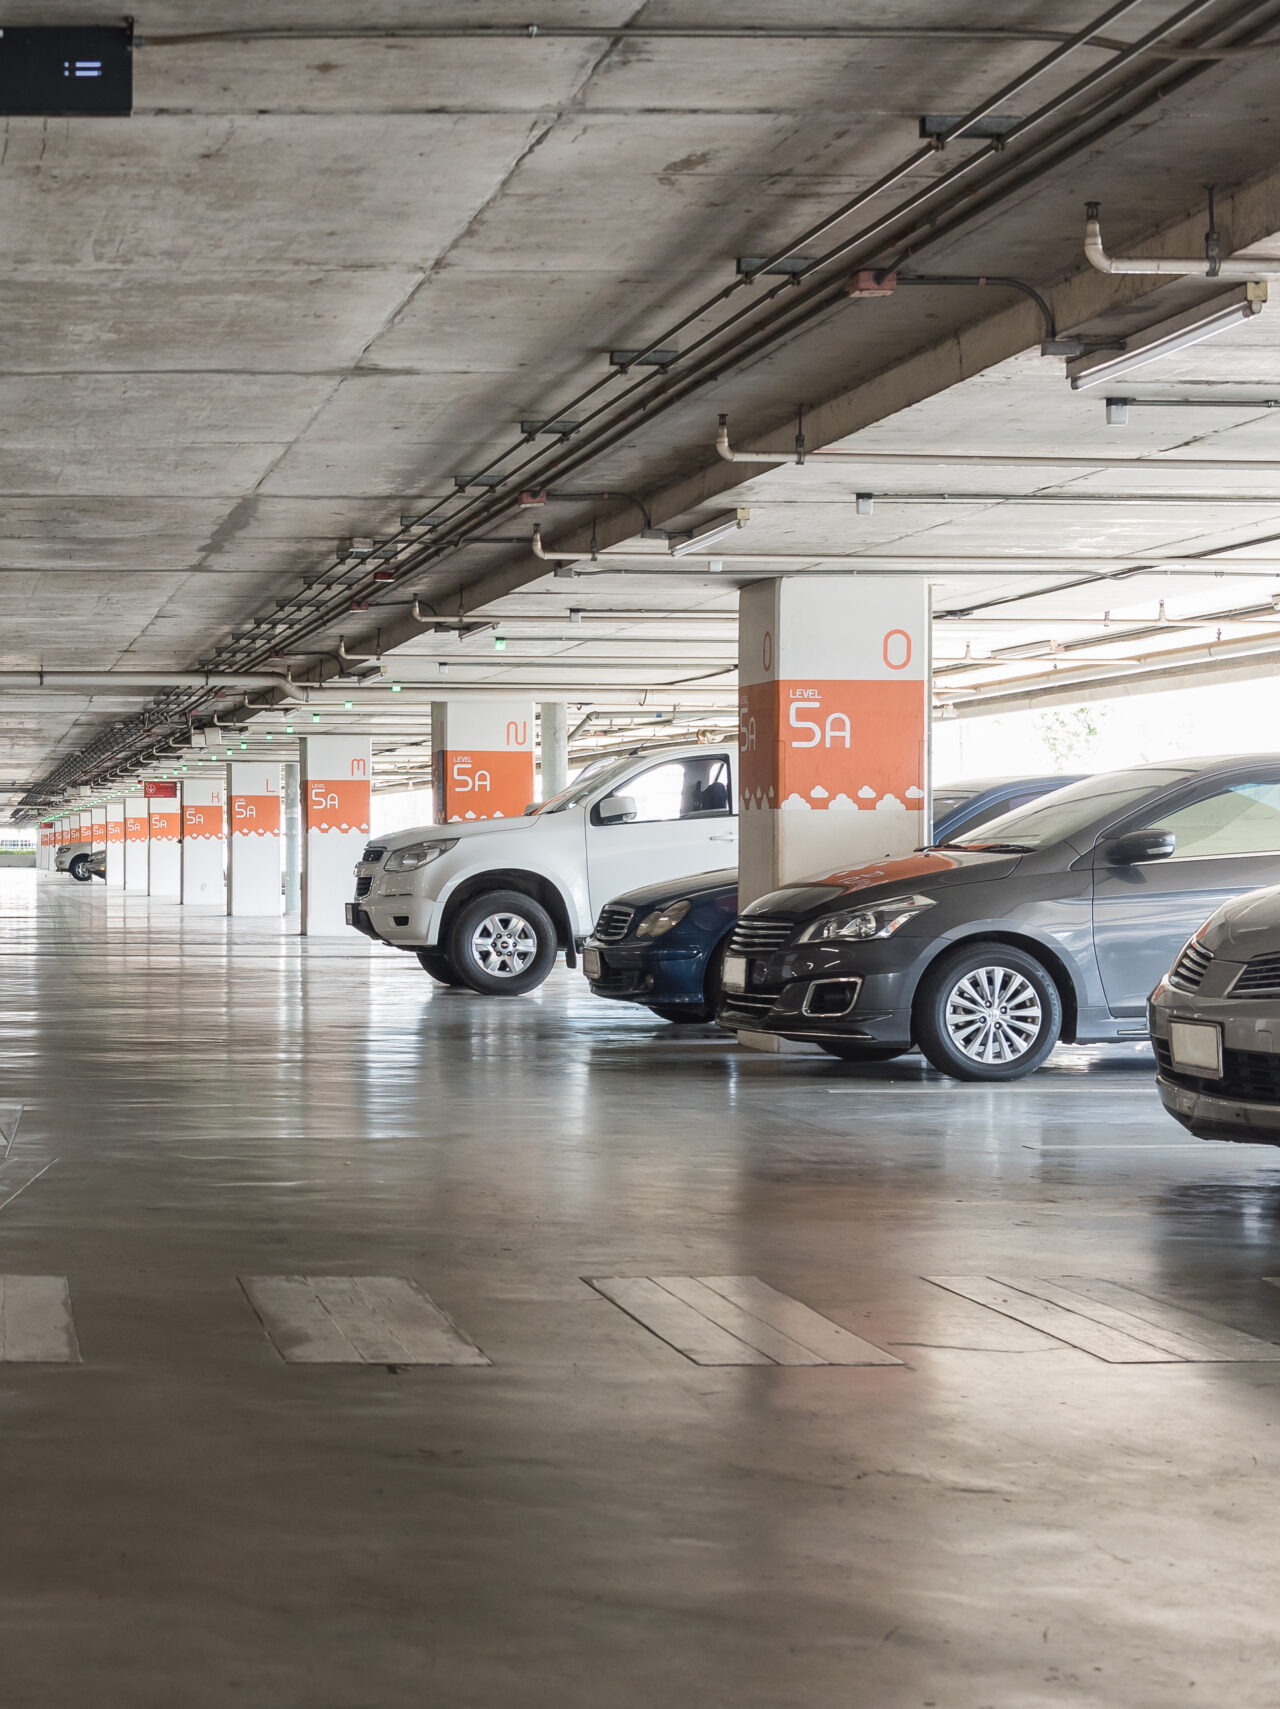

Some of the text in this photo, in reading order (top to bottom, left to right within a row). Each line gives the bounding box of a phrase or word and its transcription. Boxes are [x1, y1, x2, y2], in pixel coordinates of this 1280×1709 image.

[789, 689, 822, 698] LEVEL
[789, 702, 851, 748] 5A
[506, 721, 526, 745] N
[351, 758, 365, 776] M
[453, 764, 490, 791] 5A
[266, 779, 276, 793] L
[311, 789, 338, 809] 5A
[185, 811, 204, 824] 5A
[235, 802, 256, 818] 5A
[108, 823, 120, 834] 5A
[127, 821, 140, 831] 5A
[152, 816, 167, 829] 5A
